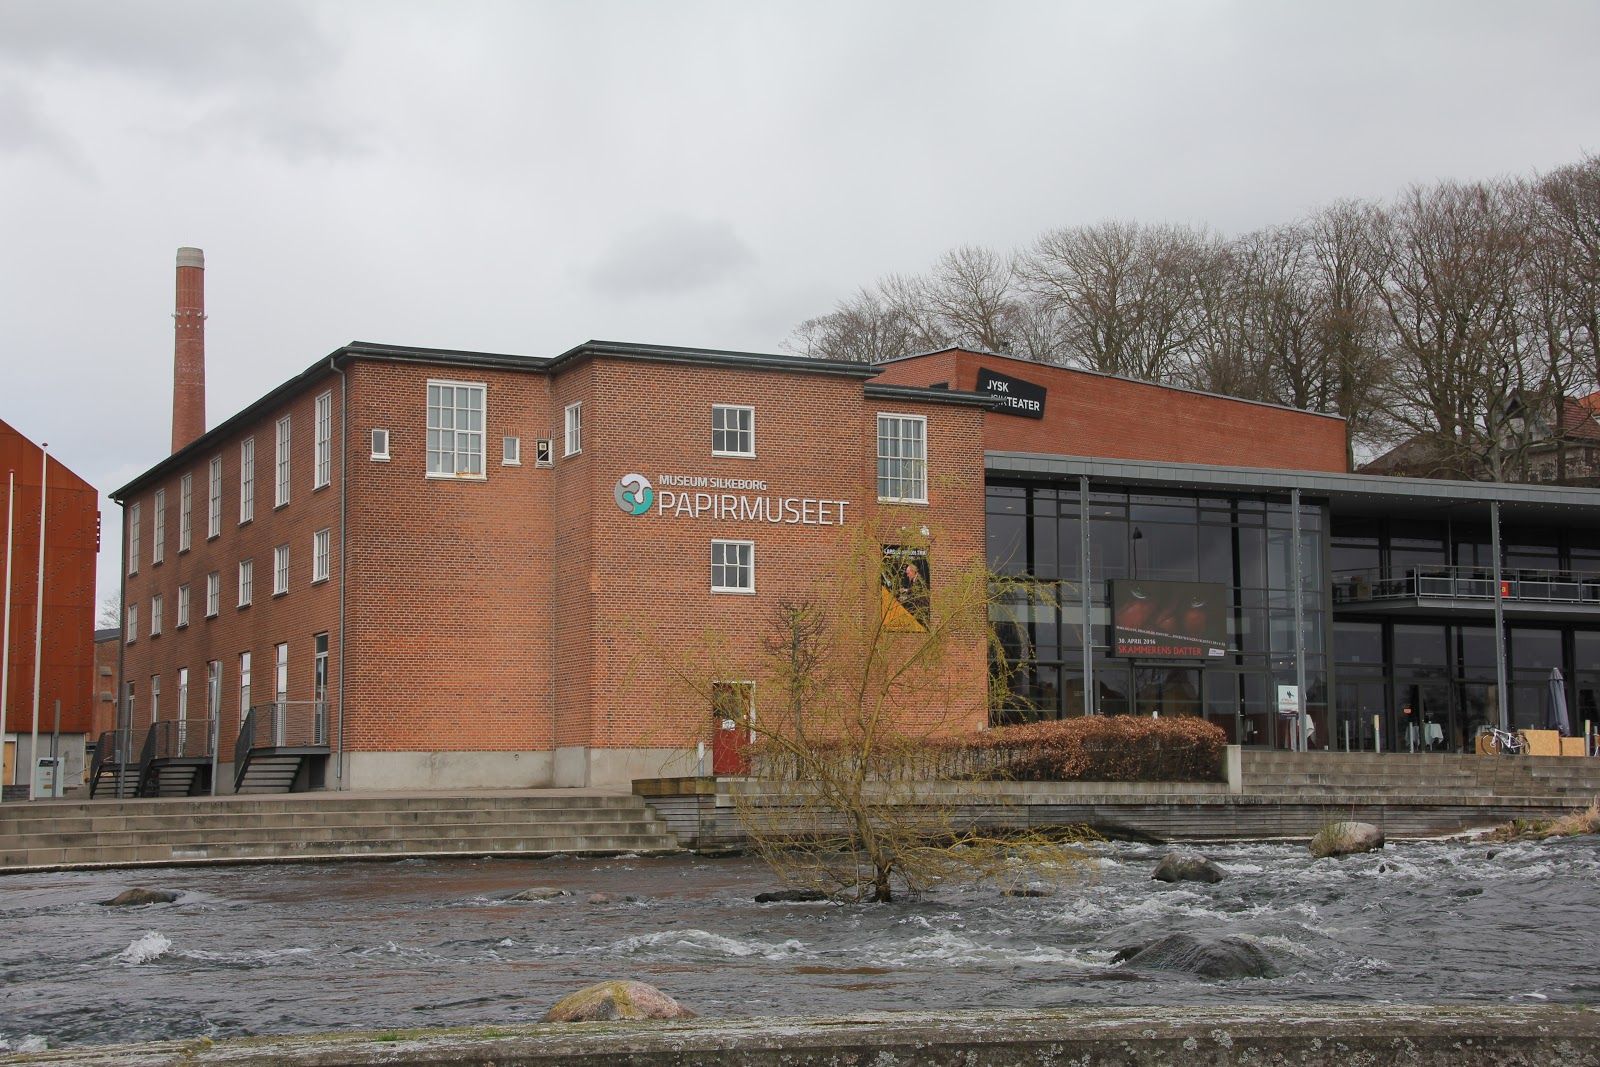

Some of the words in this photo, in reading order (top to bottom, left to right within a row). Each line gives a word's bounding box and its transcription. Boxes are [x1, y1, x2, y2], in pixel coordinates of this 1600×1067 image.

[987, 380, 1009, 393] JYSK
[659, 474, 707, 487] MUSEUM
[709, 477, 768, 491] SILKEBORG
[658, 491, 850, 525] PAPIRMUSEET
[1119, 646, 1172, 655] SKAMMERENS
[1173, 647, 1202, 656] DATTER
